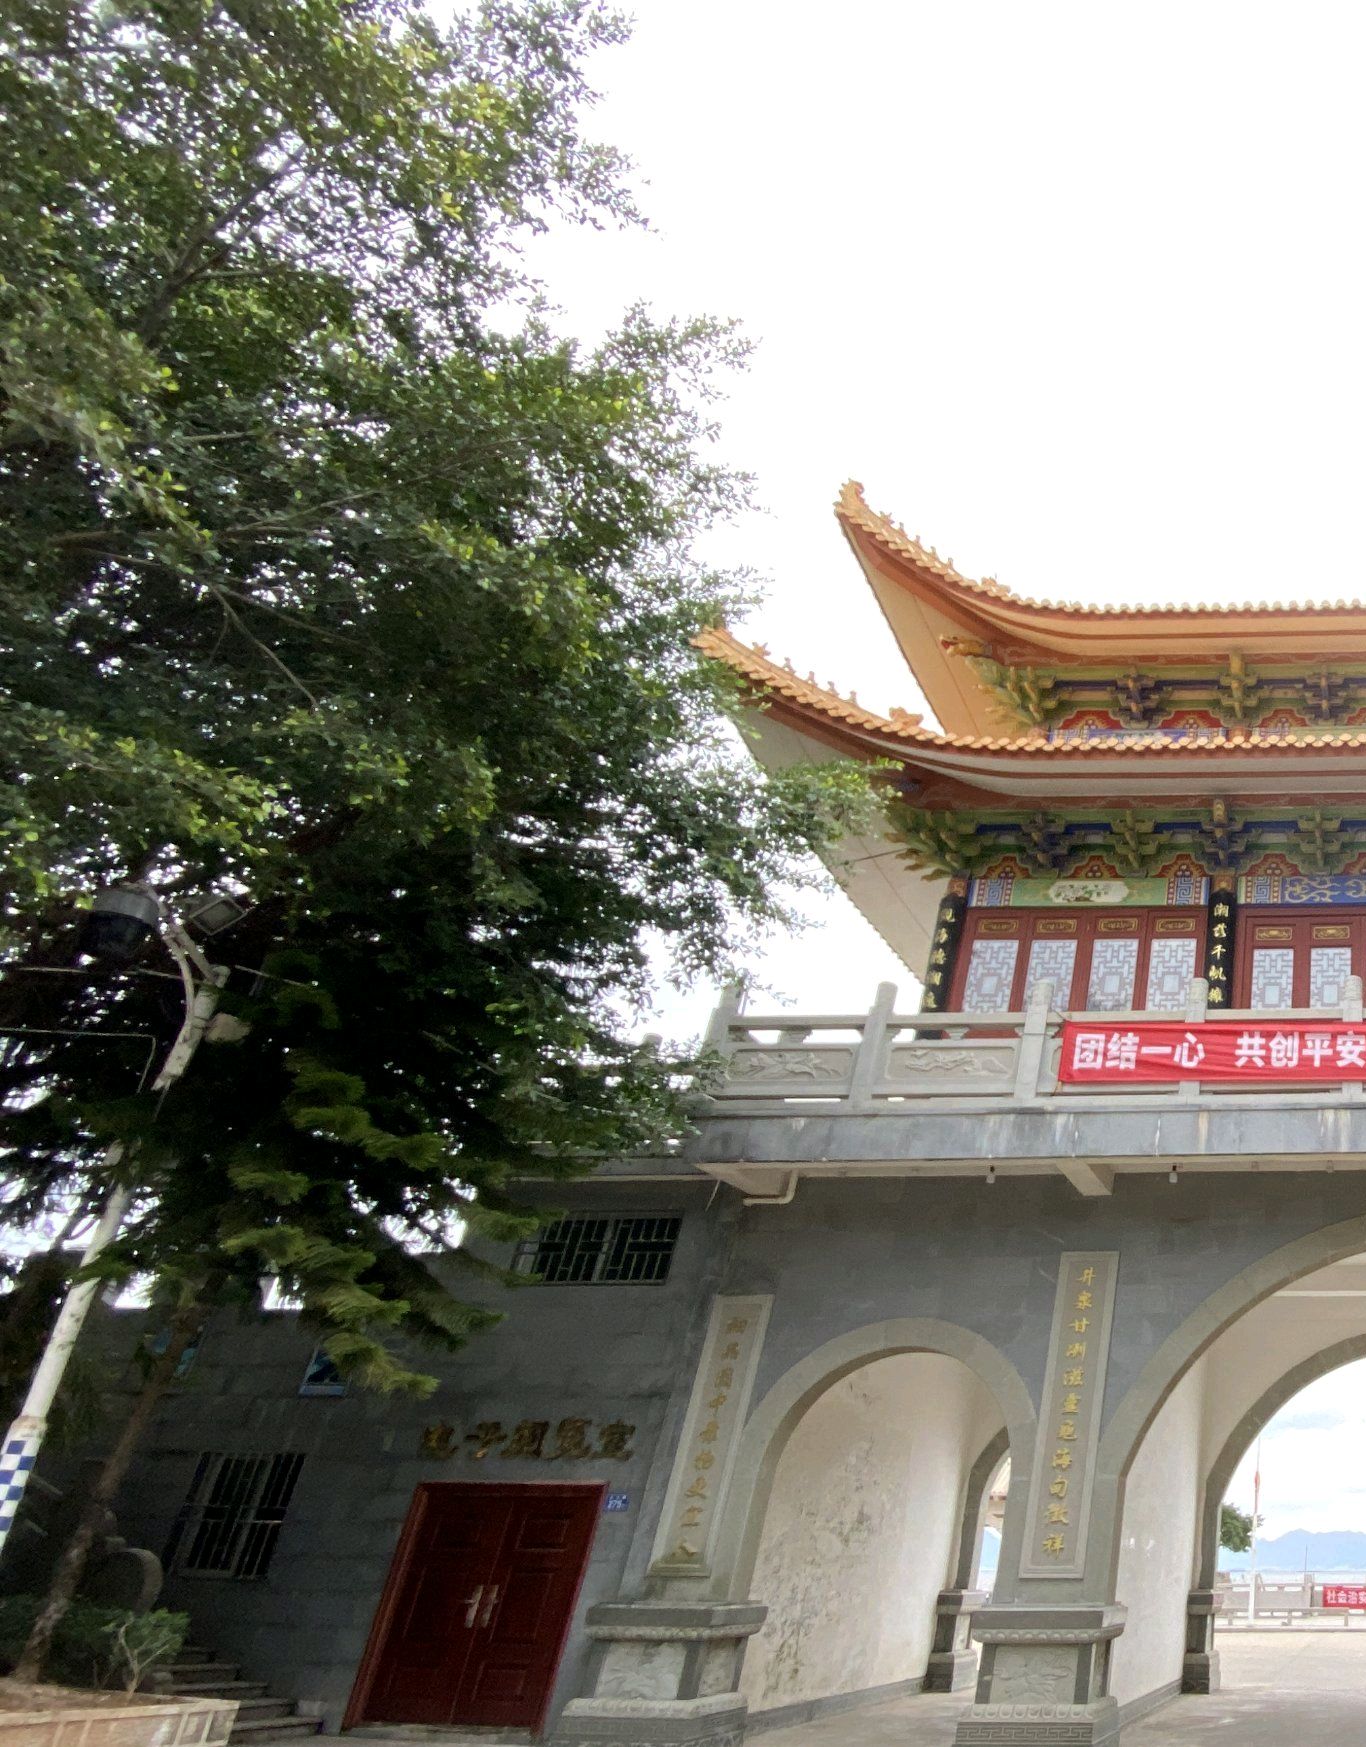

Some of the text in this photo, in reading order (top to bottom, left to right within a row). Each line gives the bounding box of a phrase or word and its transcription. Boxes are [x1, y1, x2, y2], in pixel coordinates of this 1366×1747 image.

[1072, 1031, 1206, 1070] 团结一心
[1235, 1030, 1366, 1068] 共创平安
